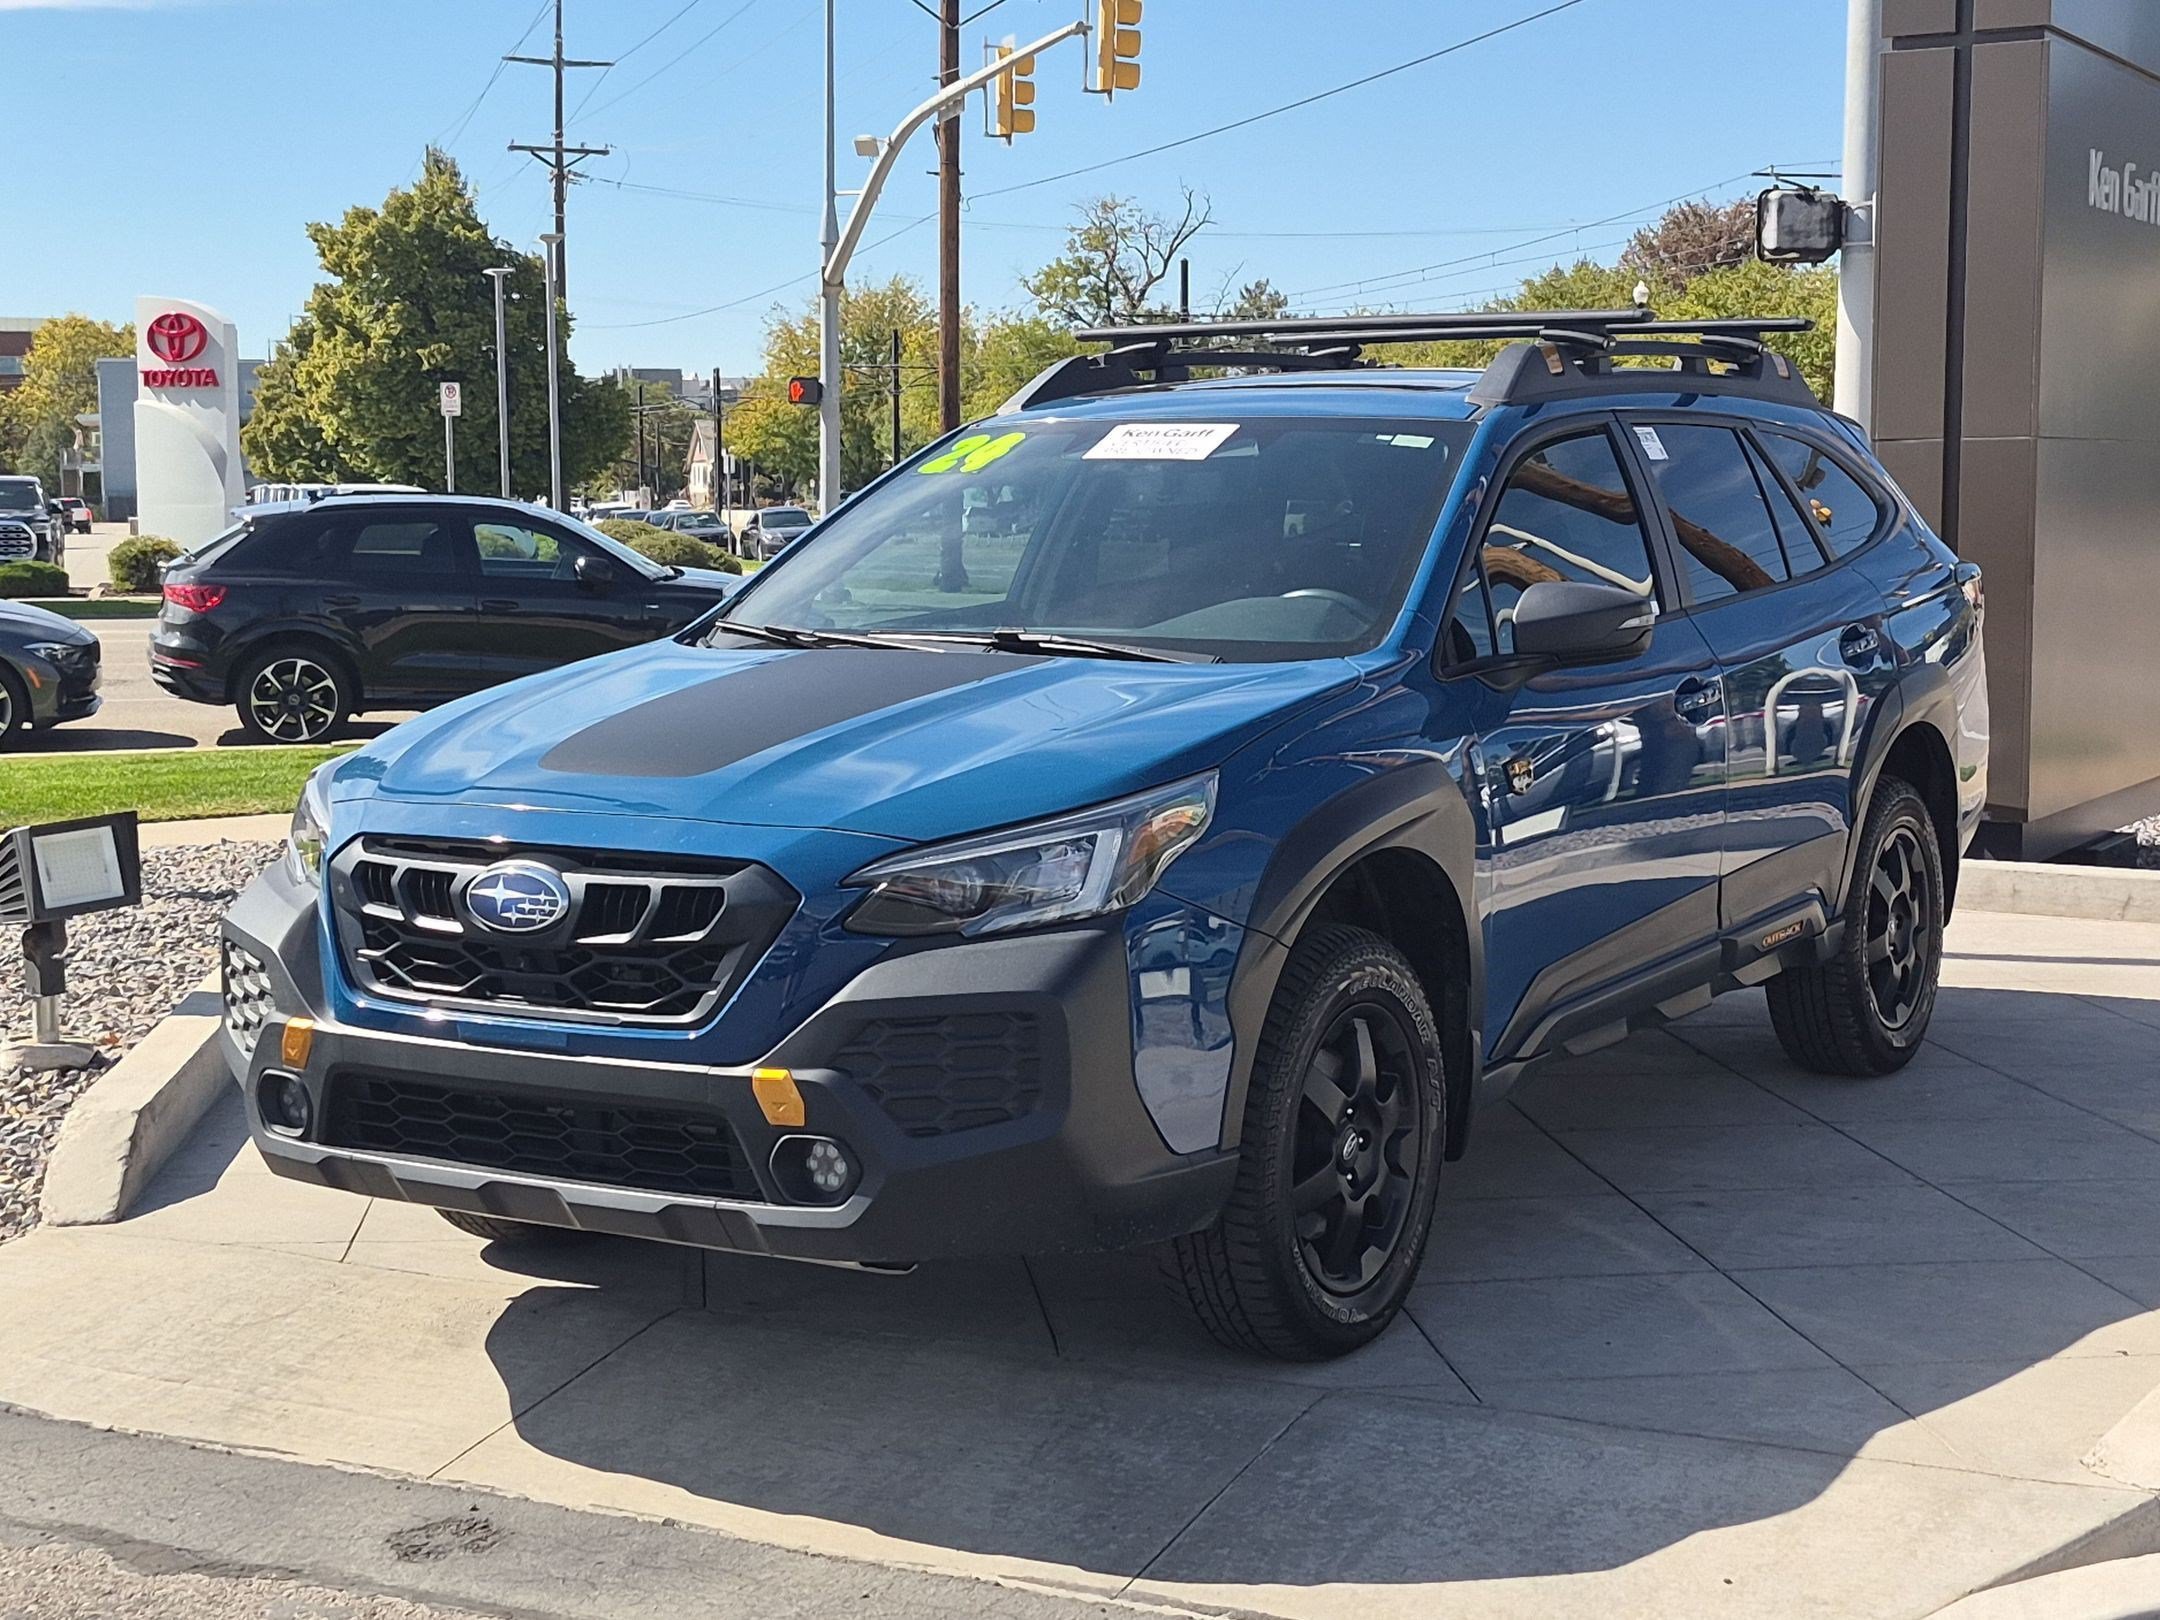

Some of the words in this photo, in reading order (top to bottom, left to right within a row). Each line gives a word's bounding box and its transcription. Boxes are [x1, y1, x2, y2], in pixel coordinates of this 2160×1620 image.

[2088, 148, 2120, 214] Ken
[139, 368, 220, 388] TOYOTA
[1122, 429, 1160, 438] Ken
[1163, 429, 1215, 438] Garff
[1762, 922, 1802, 948] OUTBACK
